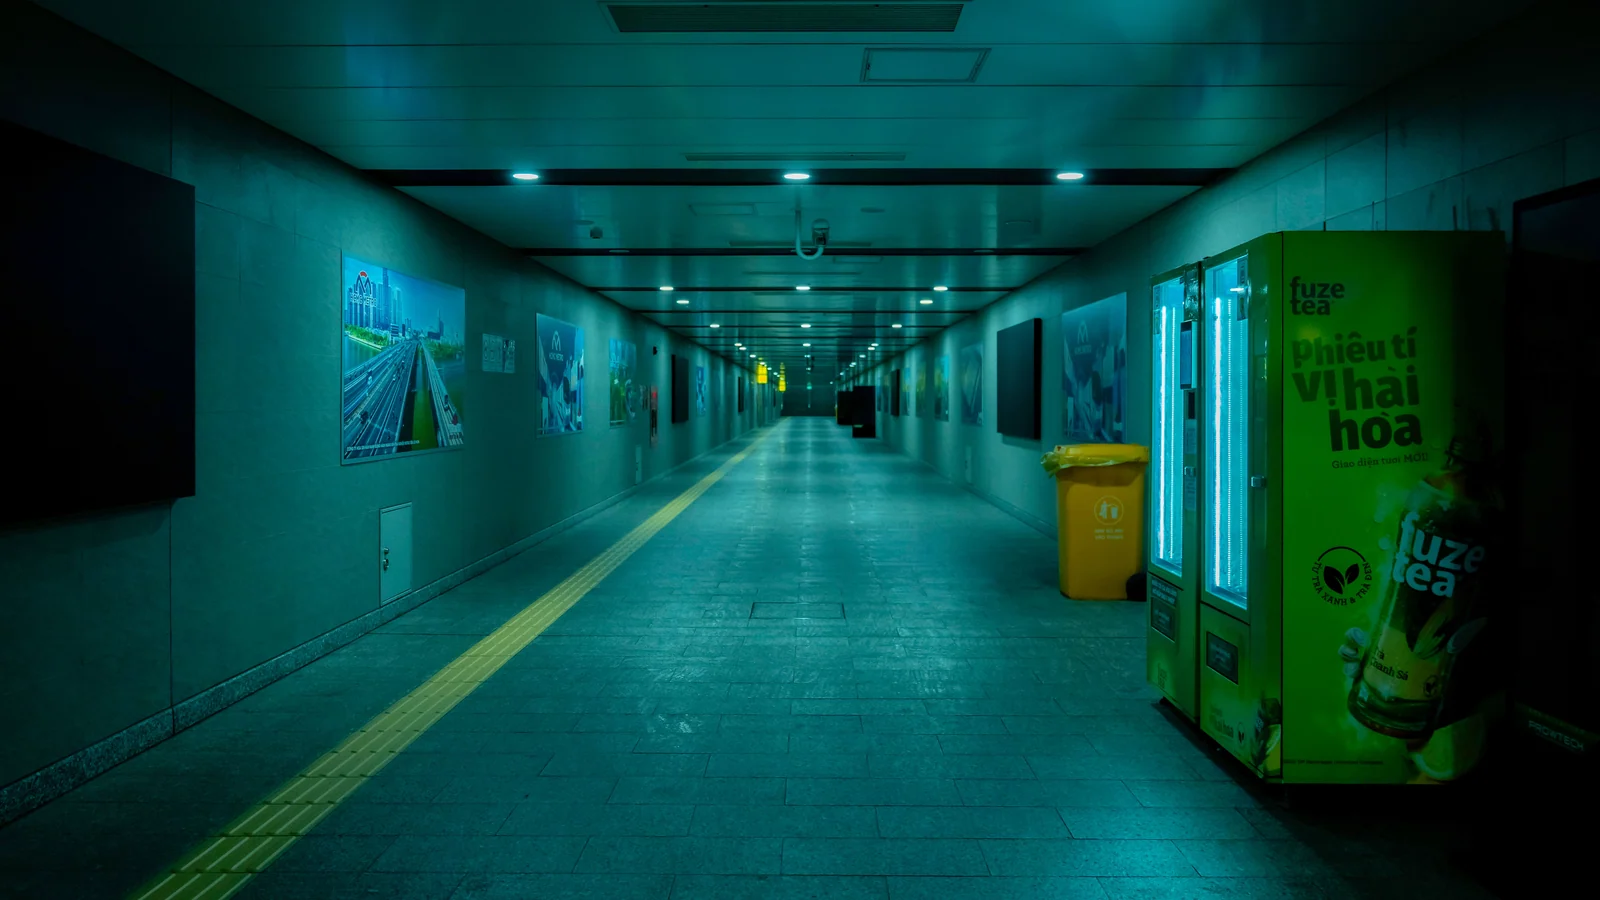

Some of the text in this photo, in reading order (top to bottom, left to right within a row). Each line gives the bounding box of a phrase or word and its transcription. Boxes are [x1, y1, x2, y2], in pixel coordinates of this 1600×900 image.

[1289, 275, 1345, 299] fuze
[1289, 296, 1331, 315] tea
[1391, 325, 1418, 359] tí
[1291, 364, 1420, 411] vị hài
[1328, 408, 1423, 452] hòa
[1331, 460, 1355, 469] Giao
[1357, 457, 1379, 469] diện
[1399, 511, 1486, 574] fuze
[1392, 551, 1456, 598] tea
[1321, 592, 1348, 606] XANH
[1355, 583, 1371, 599] TRÀ
